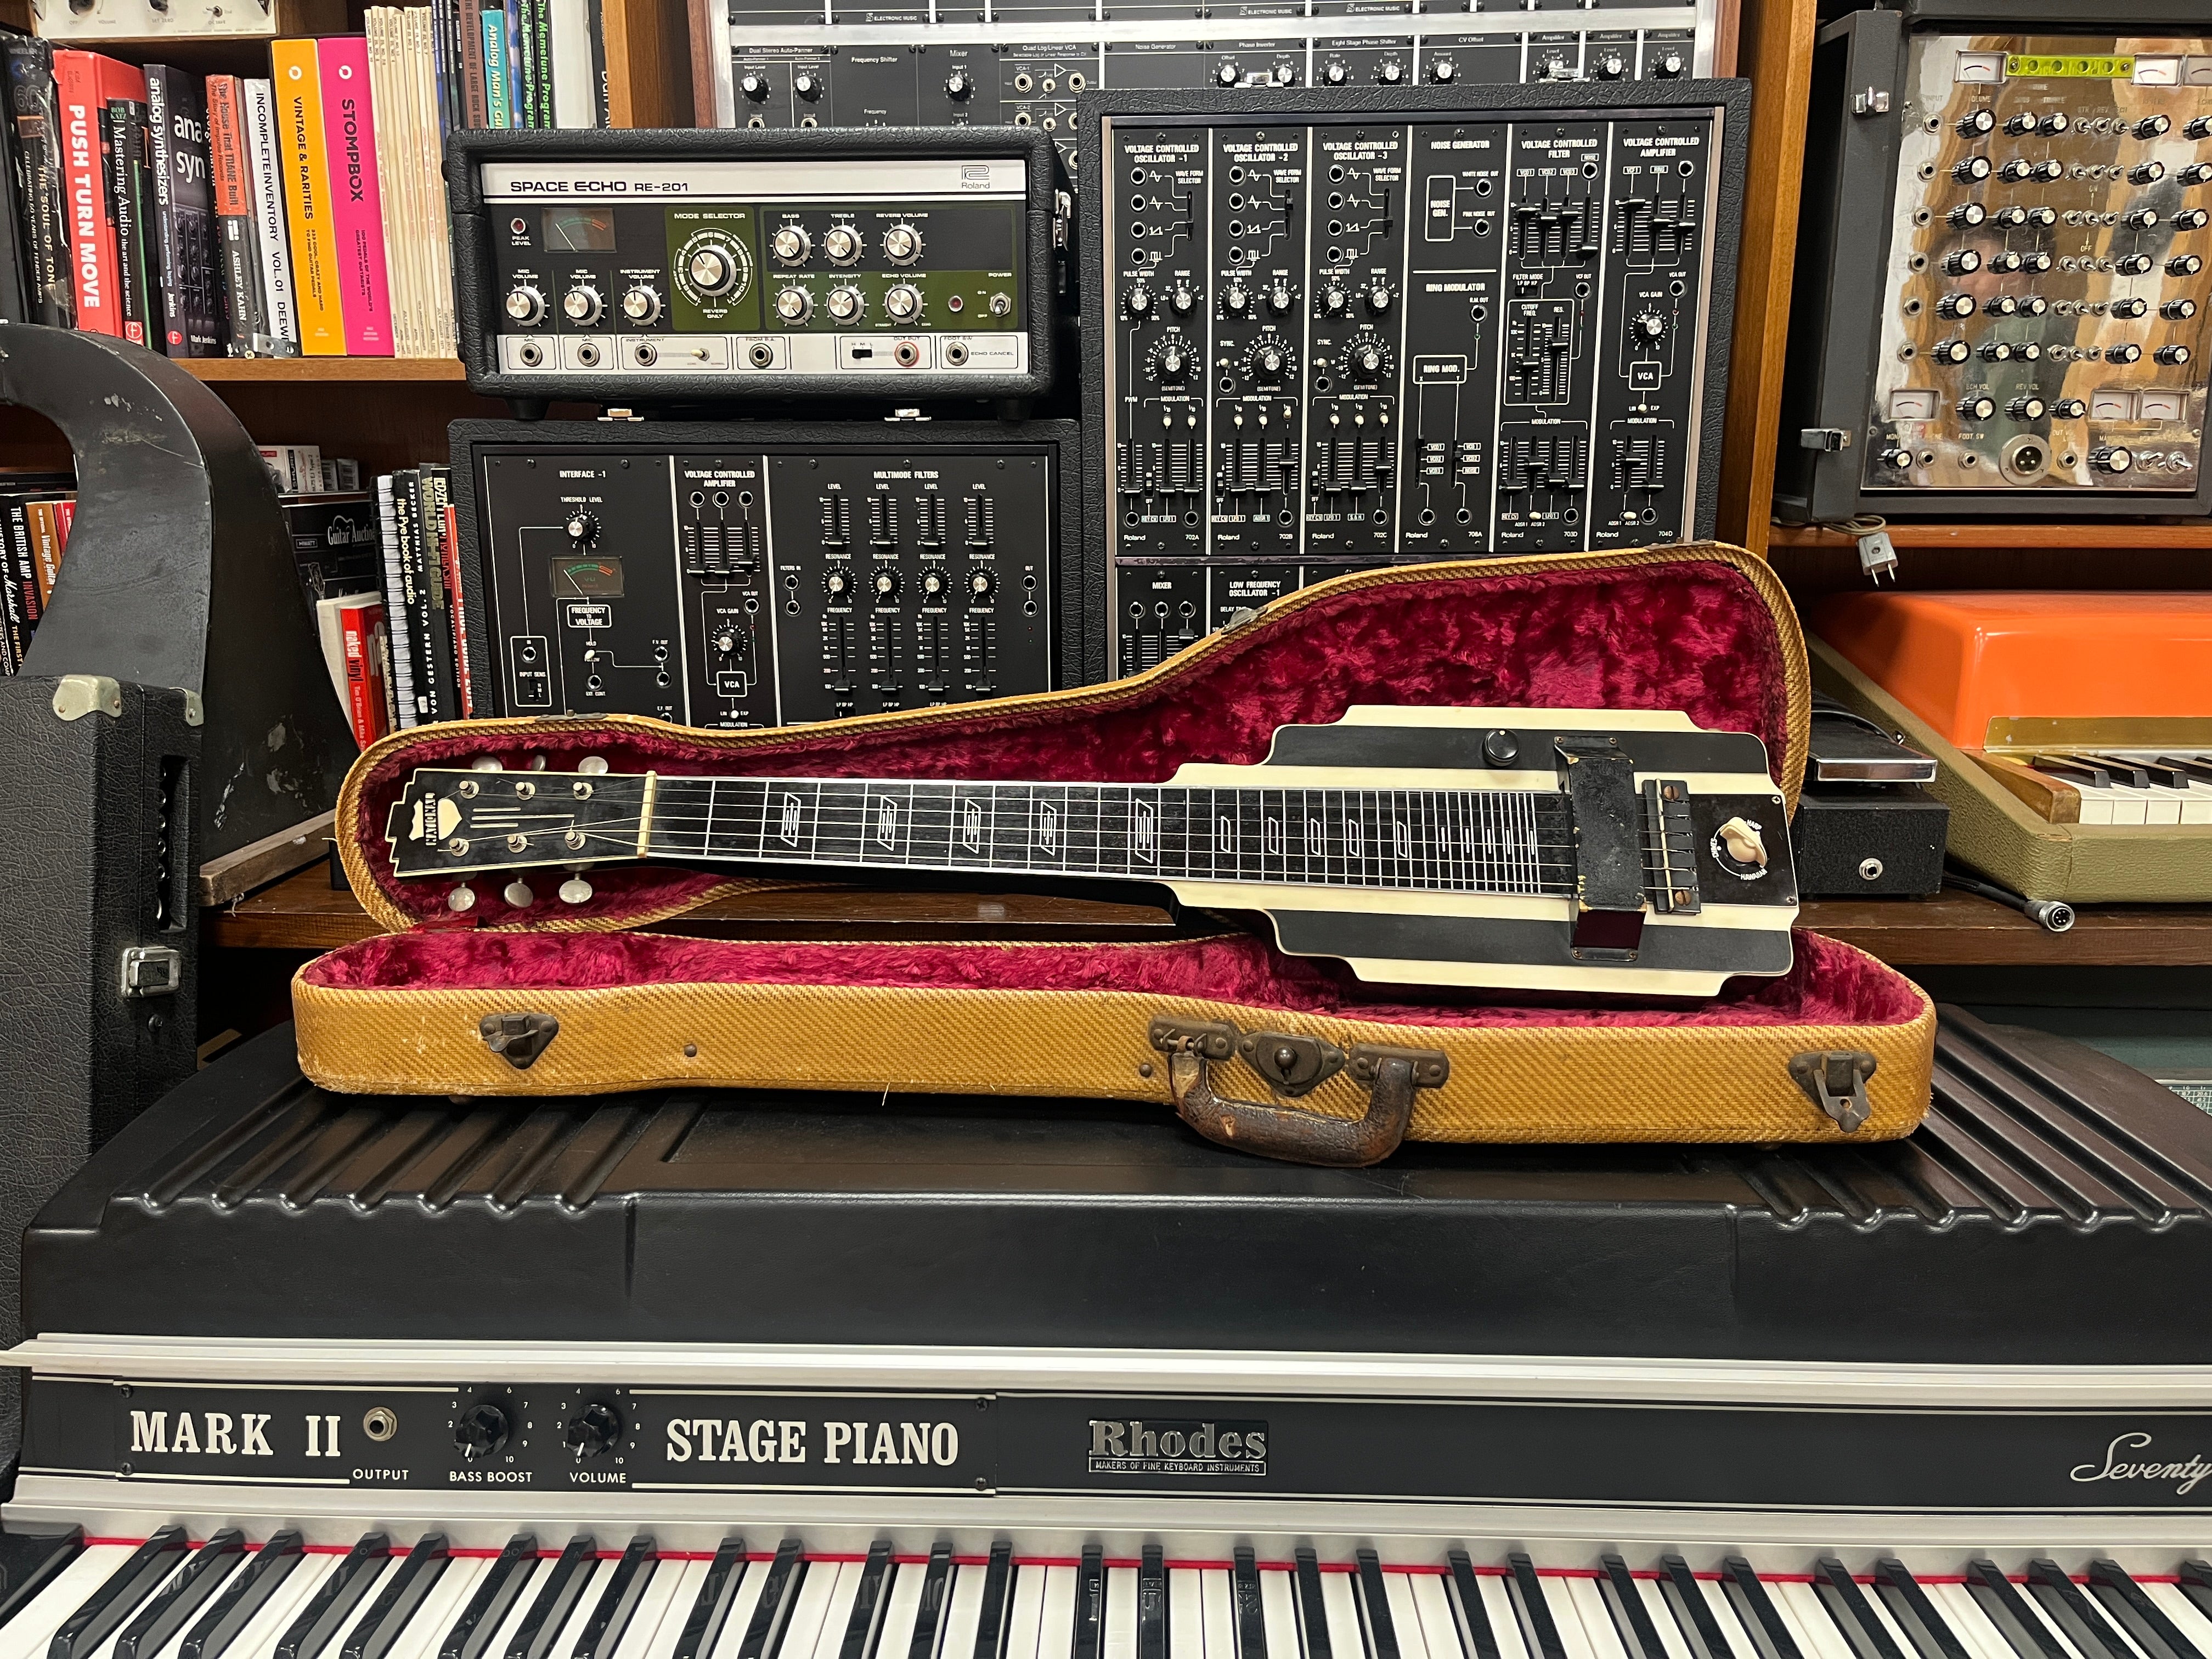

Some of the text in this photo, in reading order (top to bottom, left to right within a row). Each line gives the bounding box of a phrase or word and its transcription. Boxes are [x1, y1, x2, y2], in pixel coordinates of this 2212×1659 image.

[950, 49, 968, 58] Mixer
[488, 25, 503, 107] Analog Man's
[69, 105, 89, 167] PUSH
[149, 77, 169, 206] analog synthesizers
[1431, 140, 1489, 150] NOISE GENERATOR
[1521, 139, 1598, 149] VOLTAGE CONTROLLED
[1623, 137, 1699, 147] VOLTAGE CONTROLLED
[294, 97, 313, 220] VINTAGE & RARITIES
[342, 98, 364, 202] STOMPBOX
[1124, 144, 1199, 154] VOLTAGE CONTROLLED
[1134, 155, 1176, 163] OSCILLATOR
[1548, 150, 1570, 159] FILTER
[1640, 148, 1676, 157] AMPLIFIER
[38, 166, 46, 190] THE
[112, 126, 126, 193] Mastering
[119, 195, 132, 236] Audio
[510, 181, 689, 192] SPACE ECHO RE-201
[961, 182, 990, 190] Roland
[75, 174, 94, 236] TURN
[44, 235, 53, 251] OF
[46, 257, 56, 290] TONE
[80, 243, 100, 308] MOVE
[232, 250, 247, 321] ASHLEY KAHN
[1426, 283, 1485, 292] RING MODULATOR
[1423, 364, 1460, 373] RING MOD.
[1637, 372, 1654, 381] VCA
[409, 482, 417, 518] BECKER
[328, 526, 349, 545] Guitar
[422, 477, 444, 610] WORLD GUIDE
[397, 498, 416, 605] the Pye book of audio
[413, 523, 423, 572] MATTHIAS
[10, 506, 38, 620] THE BRITISH AMP INVASION
[1246, 580, 1281, 589] FREQUENCY
[4, 575, 20, 623] Marshall
[420, 599, 430, 627] VOL.
[346, 630, 364, 682] naked vinyl
[424, 633, 435, 684] GESTERN
[429, 691, 438, 714] VON
[1747, 819, 1762, 830] HARP
[1710, 838, 1719, 858] CHIMES
[1740, 868, 1768, 881] HAWAIIAN
[130, 1410, 341, 1457] MARK II
[666, 1418, 960, 1466] STAGE PIANO
[1089, 1420, 1266, 1459] Rhodes
[352, 1468, 409, 1481] OUTPUT
[1096, 1461, 1260, 1472] MAKERS OF FINE KEYBOARD INSTRUMENTS
[2070, 1432, 2212, 1496] Seventy
[449, 1471, 533, 1483] BASS BOOST
[569, 1471, 627, 1484] VOLUME
